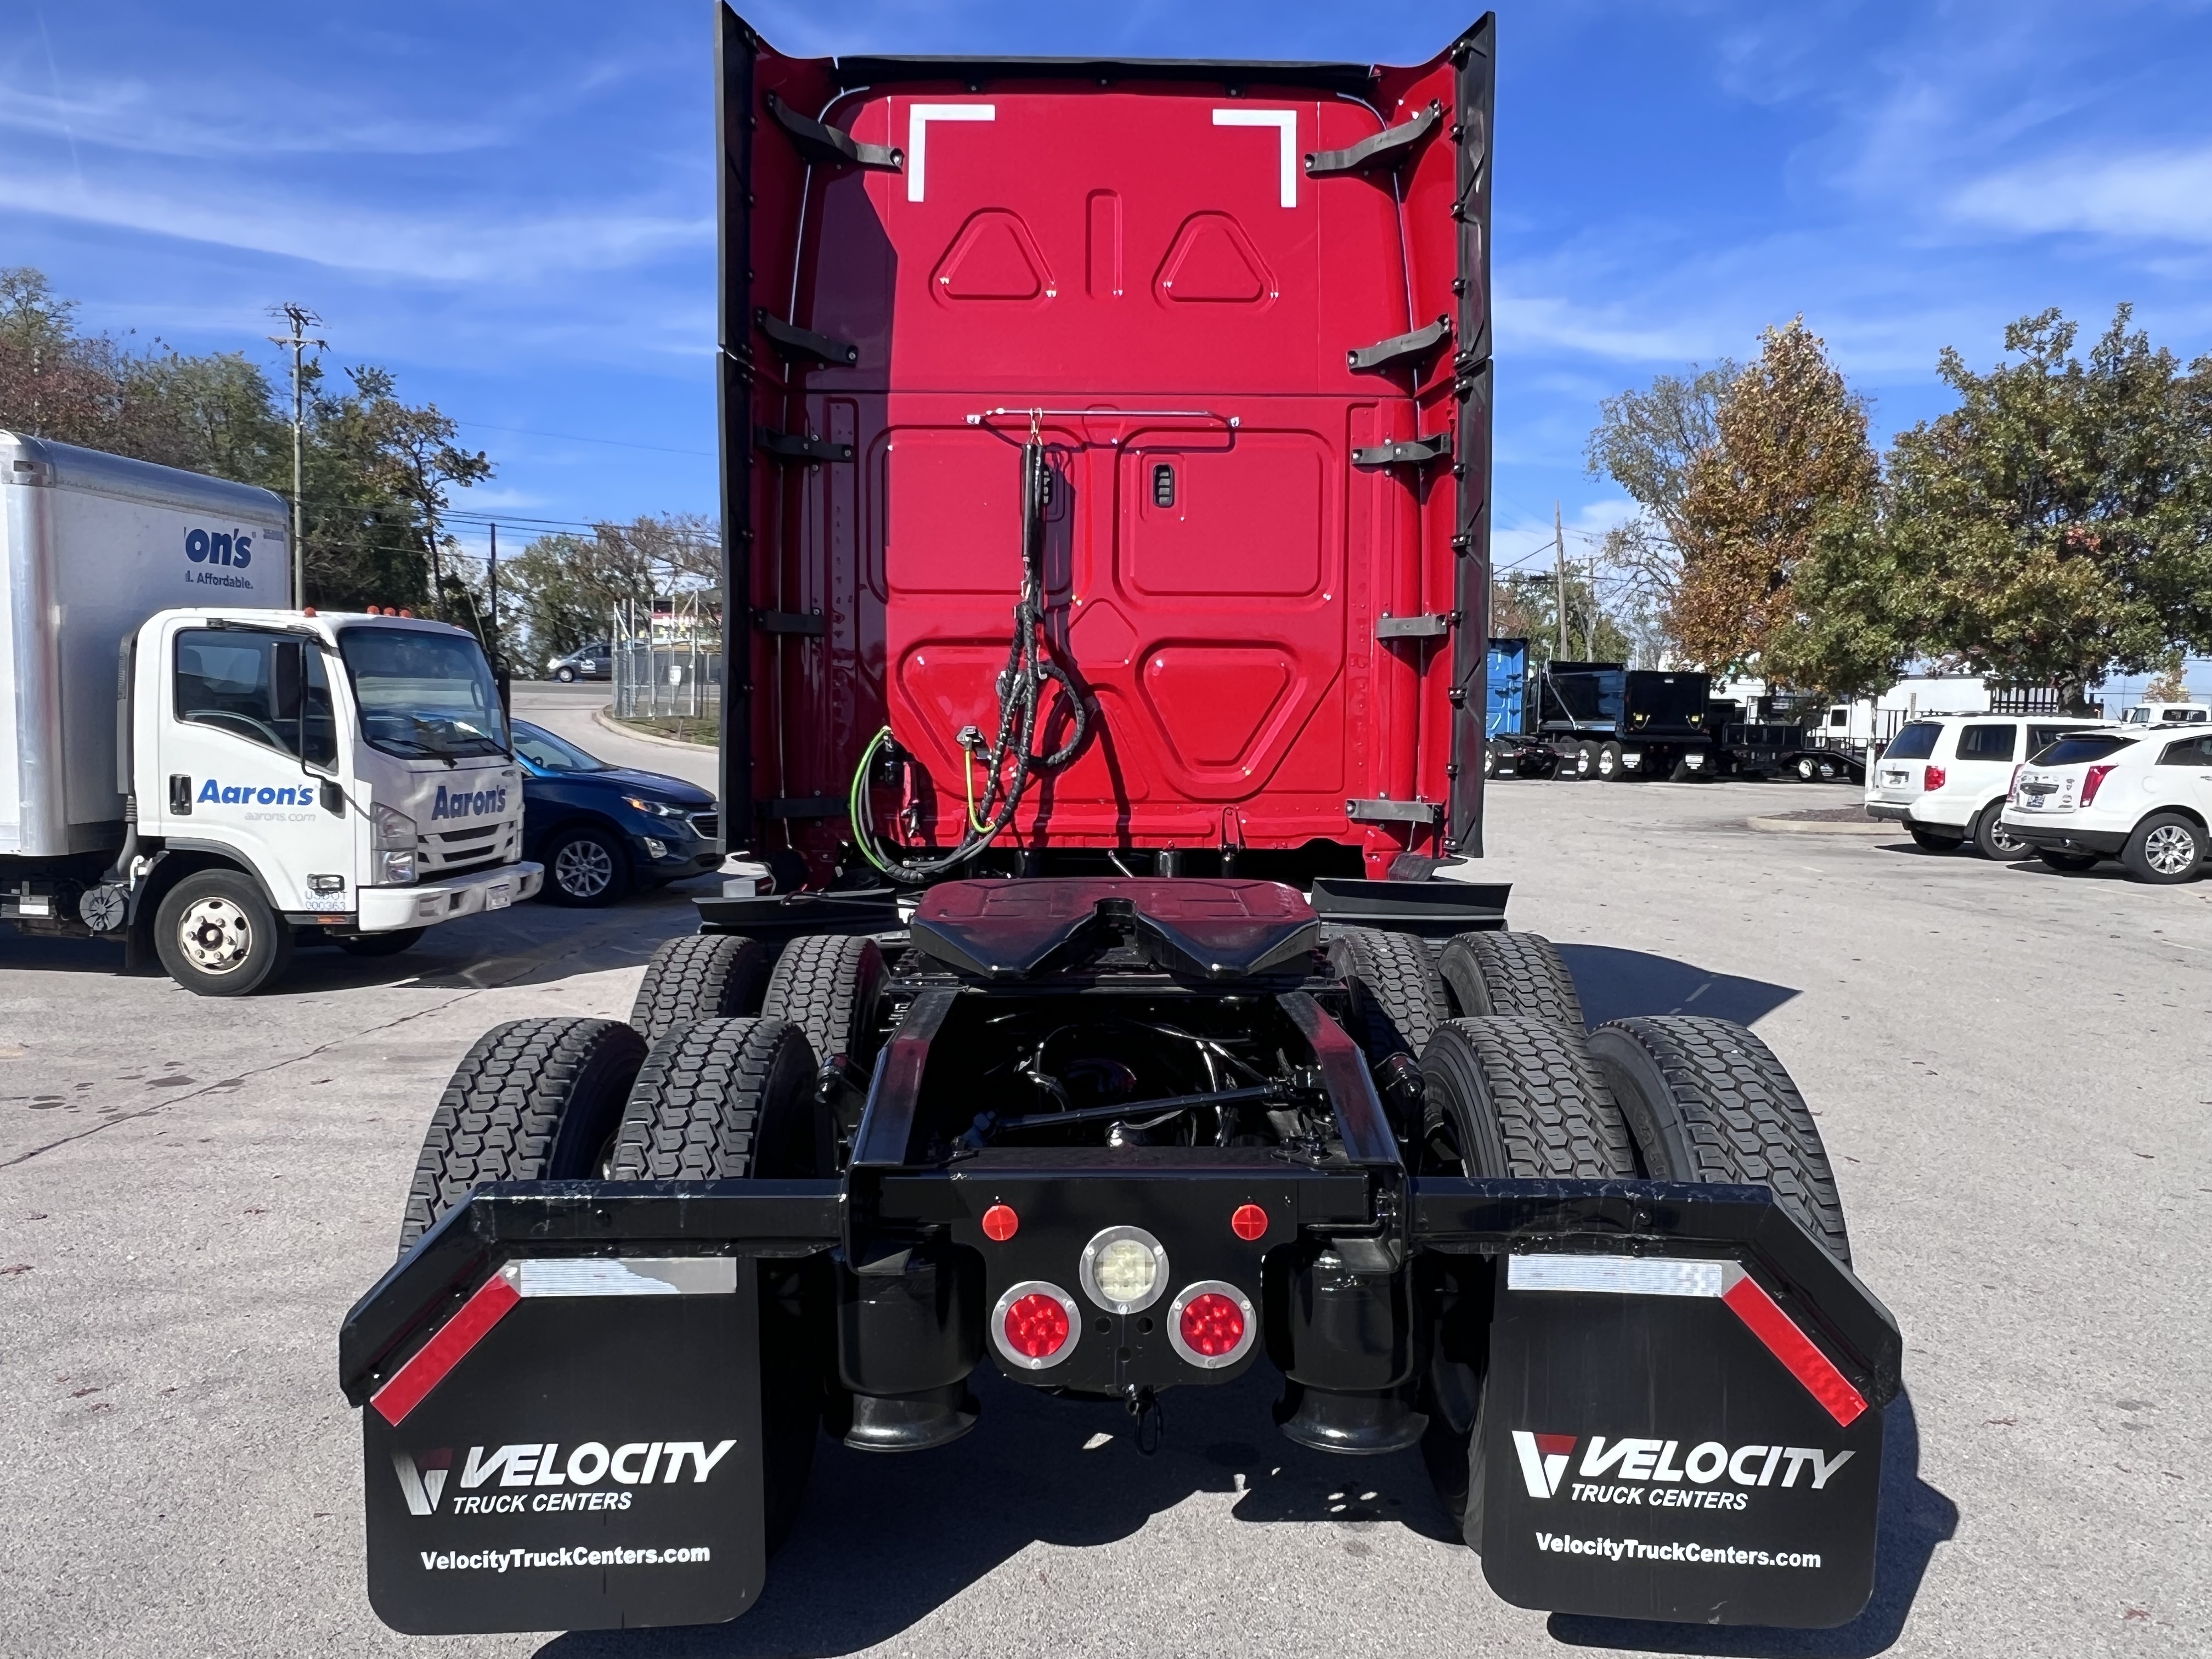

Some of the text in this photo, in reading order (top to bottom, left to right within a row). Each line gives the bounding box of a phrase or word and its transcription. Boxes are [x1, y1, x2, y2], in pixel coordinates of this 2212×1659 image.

[184, 527, 252, 568] on's
[197, 572, 253, 589] Affordable.
[196, 779, 313, 805] Aaron's
[431, 785, 506, 820] Aaron's
[245, 812, 316, 822] aarons.com
[460, 1440, 737, 1488] VELOCITY
[1579, 1436, 1856, 1489] VELOCITY
[453, 1492, 633, 1514] TRUCK CENTERS
[1571, 1483, 1748, 1511] TRUCK CENTERS
[421, 1546, 710, 1573] VelocityTruckCenters.com
[1536, 1532, 1821, 1568] VelocityTruckCenters.com
